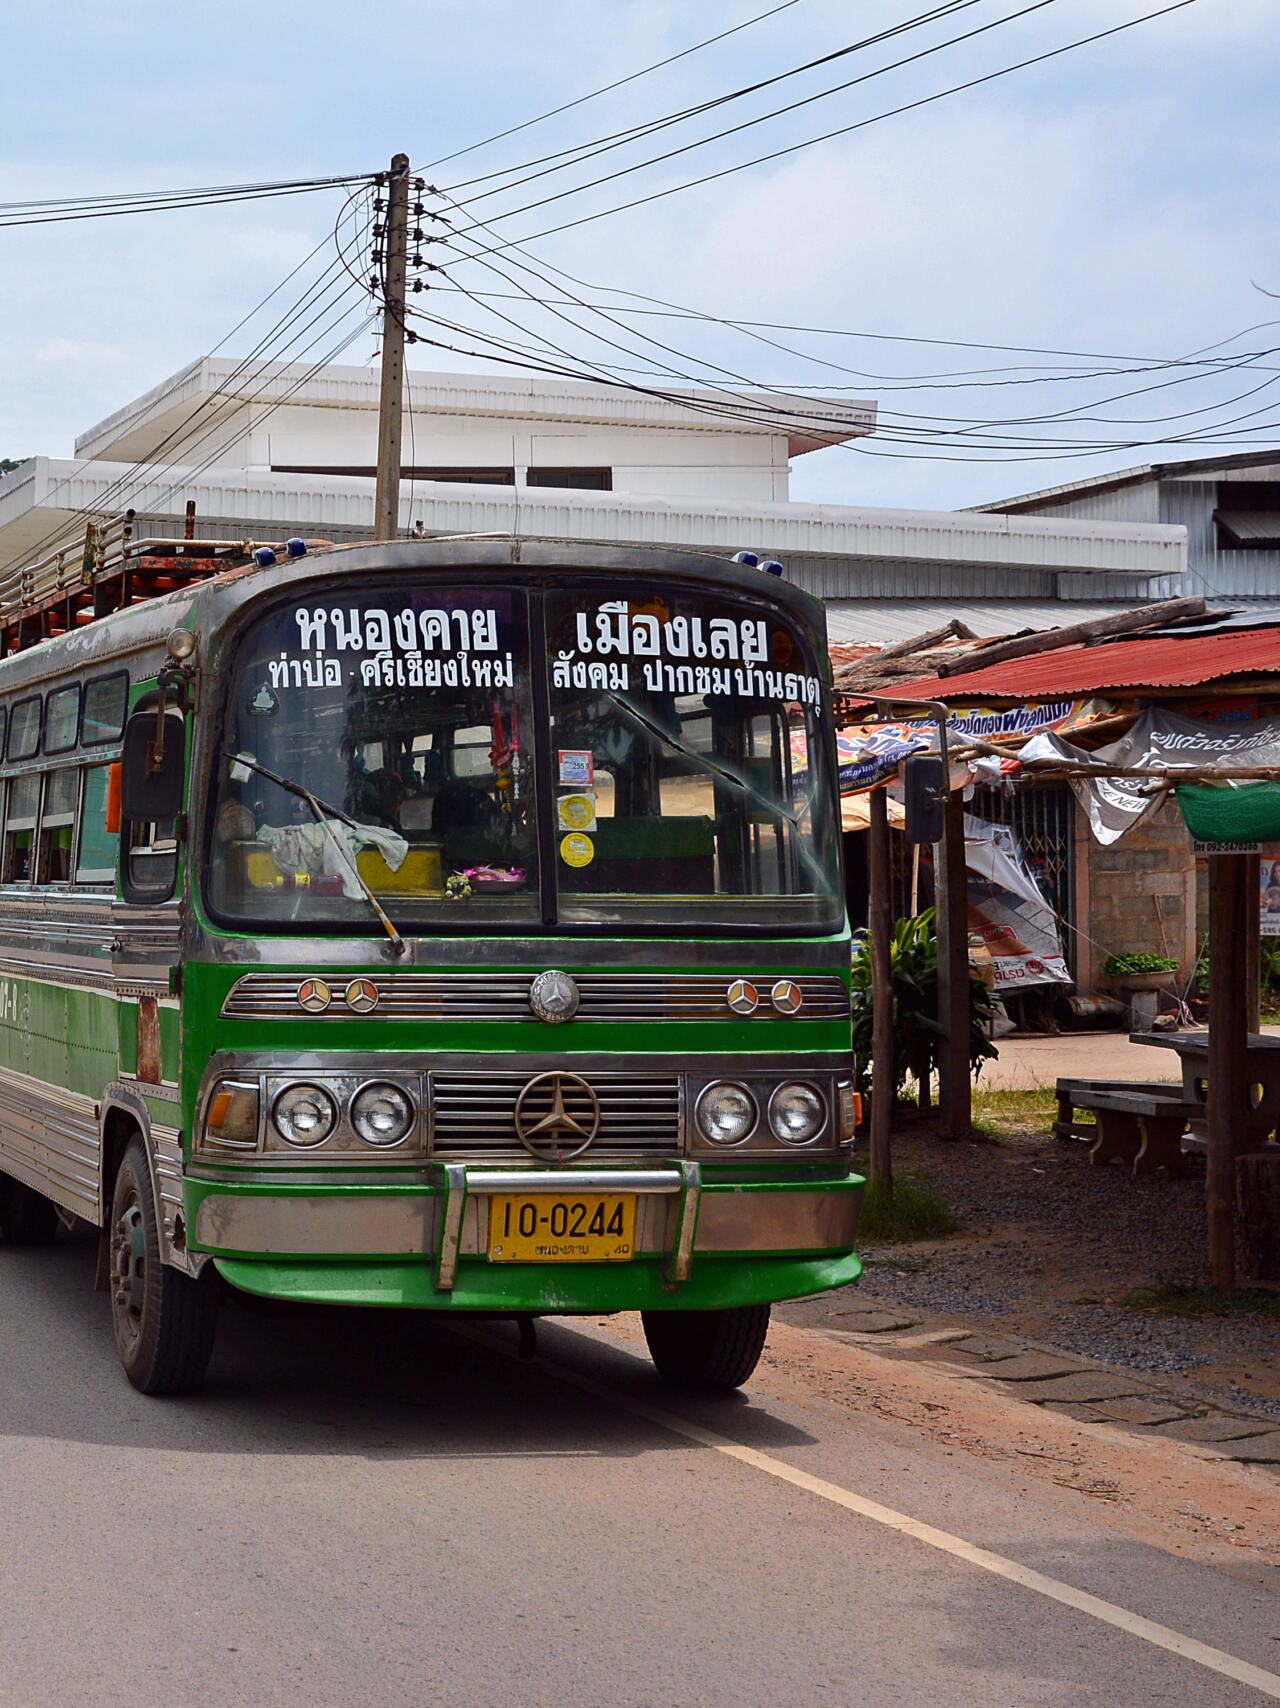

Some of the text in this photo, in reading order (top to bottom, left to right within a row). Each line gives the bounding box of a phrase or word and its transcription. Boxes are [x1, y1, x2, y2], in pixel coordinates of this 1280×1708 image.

[295, 608, 498, 650] หนองคาย
[576, 600, 768, 662] เมืองเลย
[268, 650, 514, 688] ท่าบ่อ ศรีเชียงใหม่
[553, 650, 821, 718] สังคม ปากชม บ้านธาตุ
[504, 1202, 624, 1238] 10-0244
